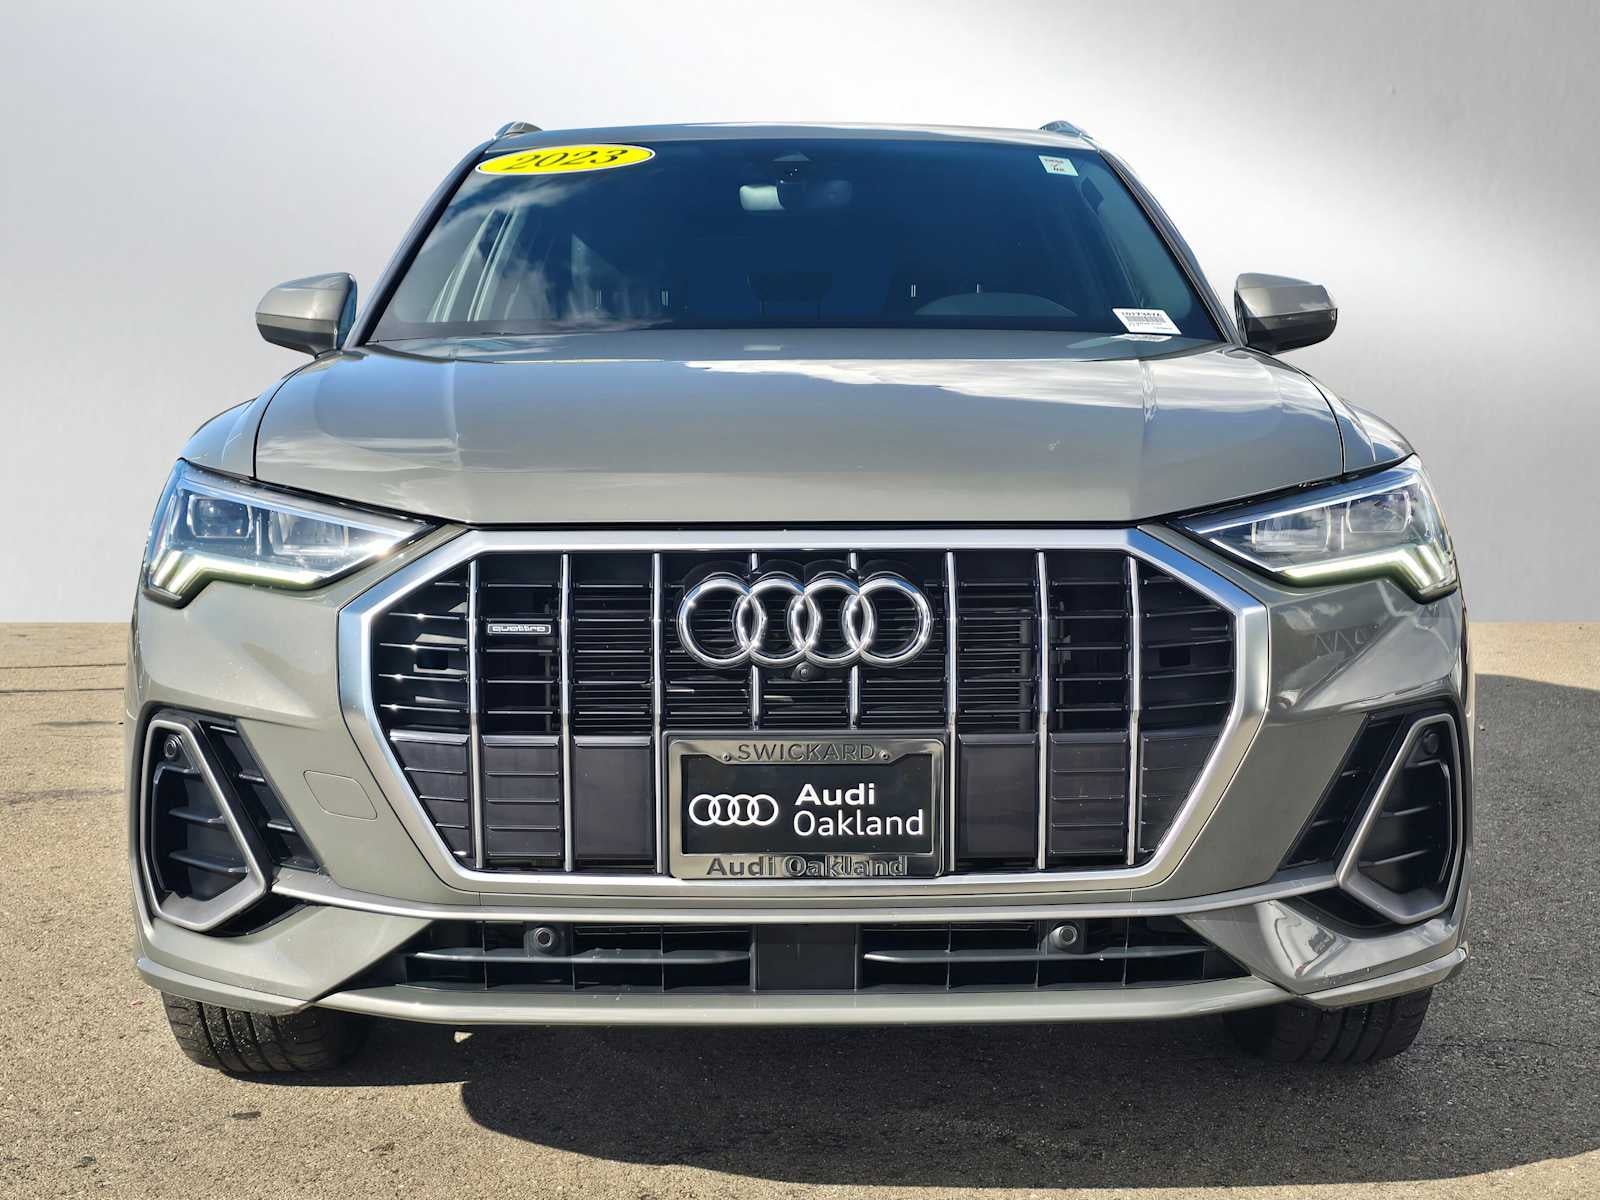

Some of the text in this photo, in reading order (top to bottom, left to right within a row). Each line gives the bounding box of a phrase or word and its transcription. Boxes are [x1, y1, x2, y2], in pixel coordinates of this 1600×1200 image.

[502, 149, 629, 171] 2023
[492, 624, 546, 633] quattro
[737, 743, 876, 762] SWICKARD
[794, 783, 875, 806] Audi
[793, 808, 924, 836] Oakland
[706, 855, 908, 876] Audi Oakland
